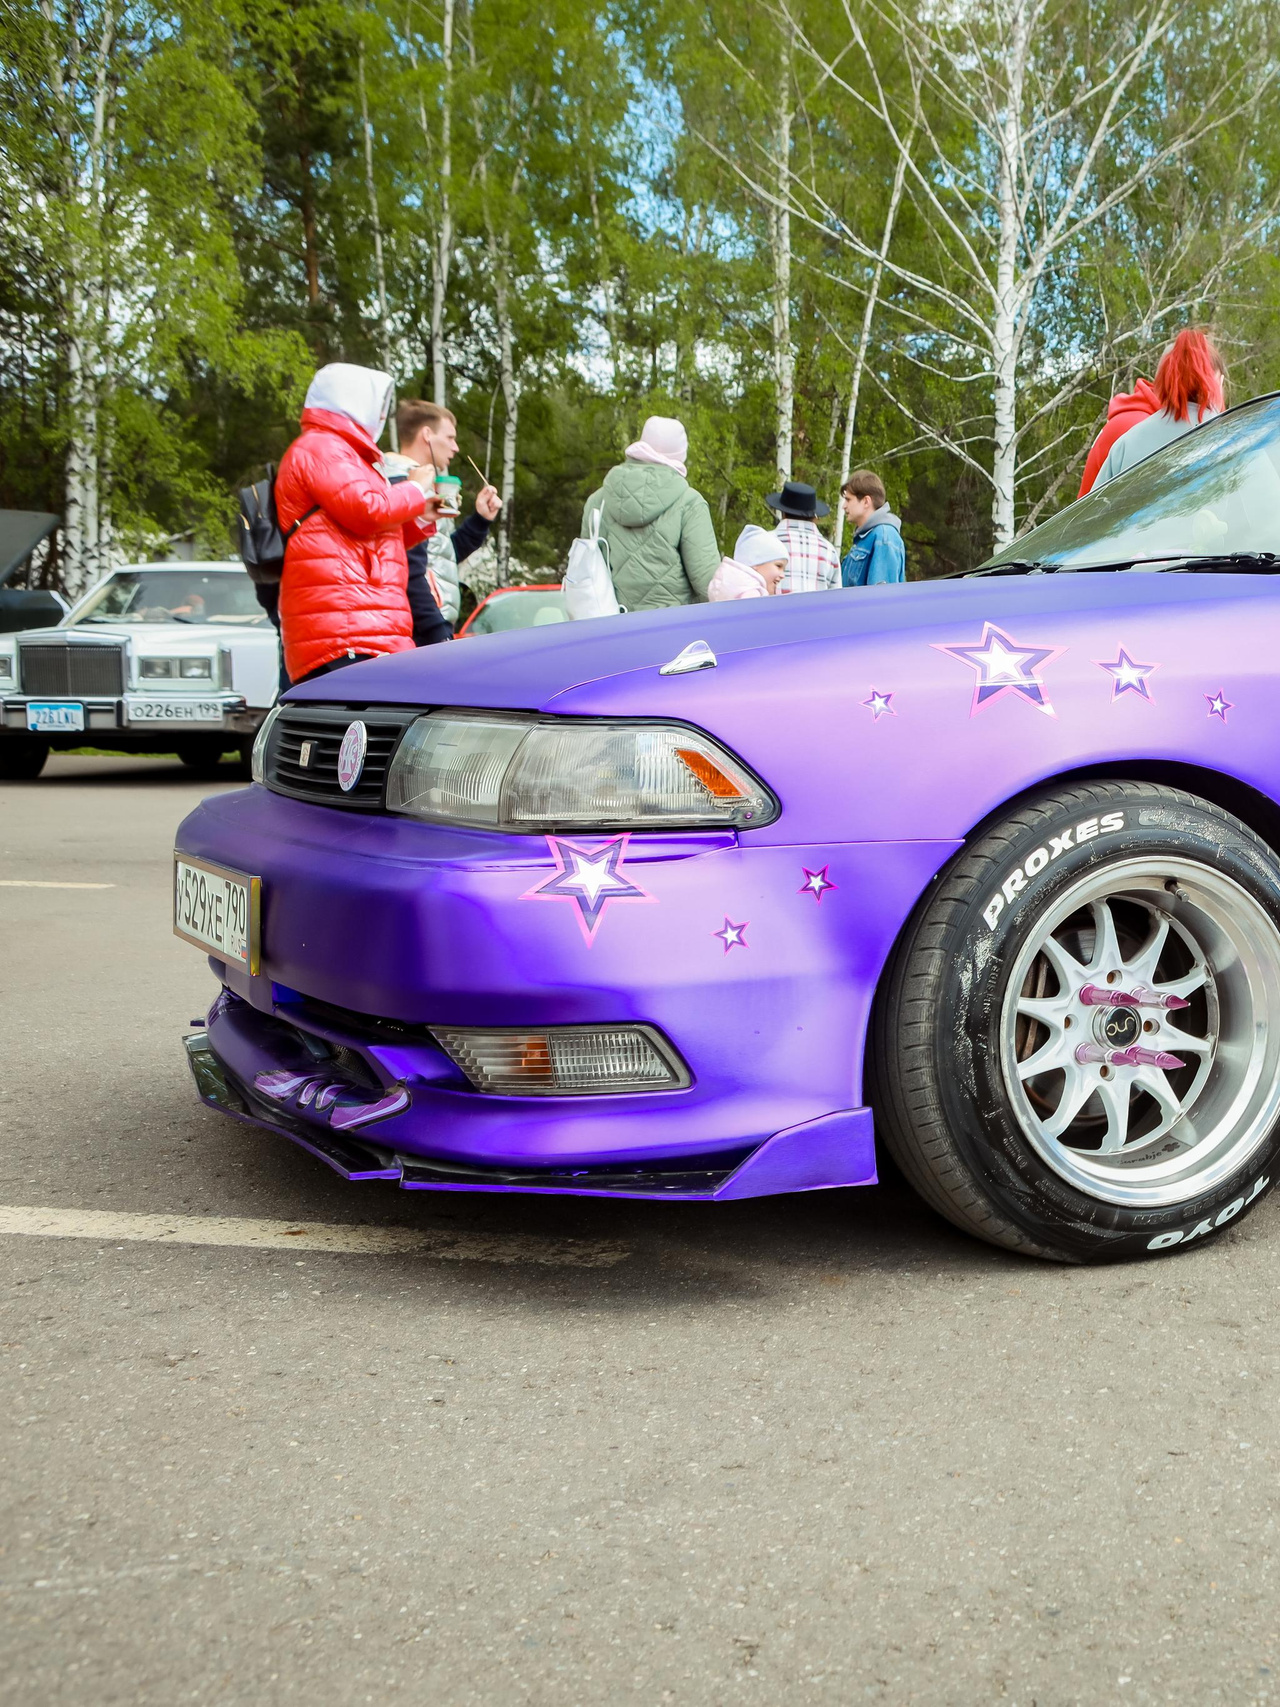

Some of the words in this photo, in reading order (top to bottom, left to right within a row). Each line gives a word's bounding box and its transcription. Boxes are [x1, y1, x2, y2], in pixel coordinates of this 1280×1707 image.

[224, 881, 247, 935] 790
[982, 811, 1125, 932] PROXES
[1146, 1175, 1270, 1250] TOYO
